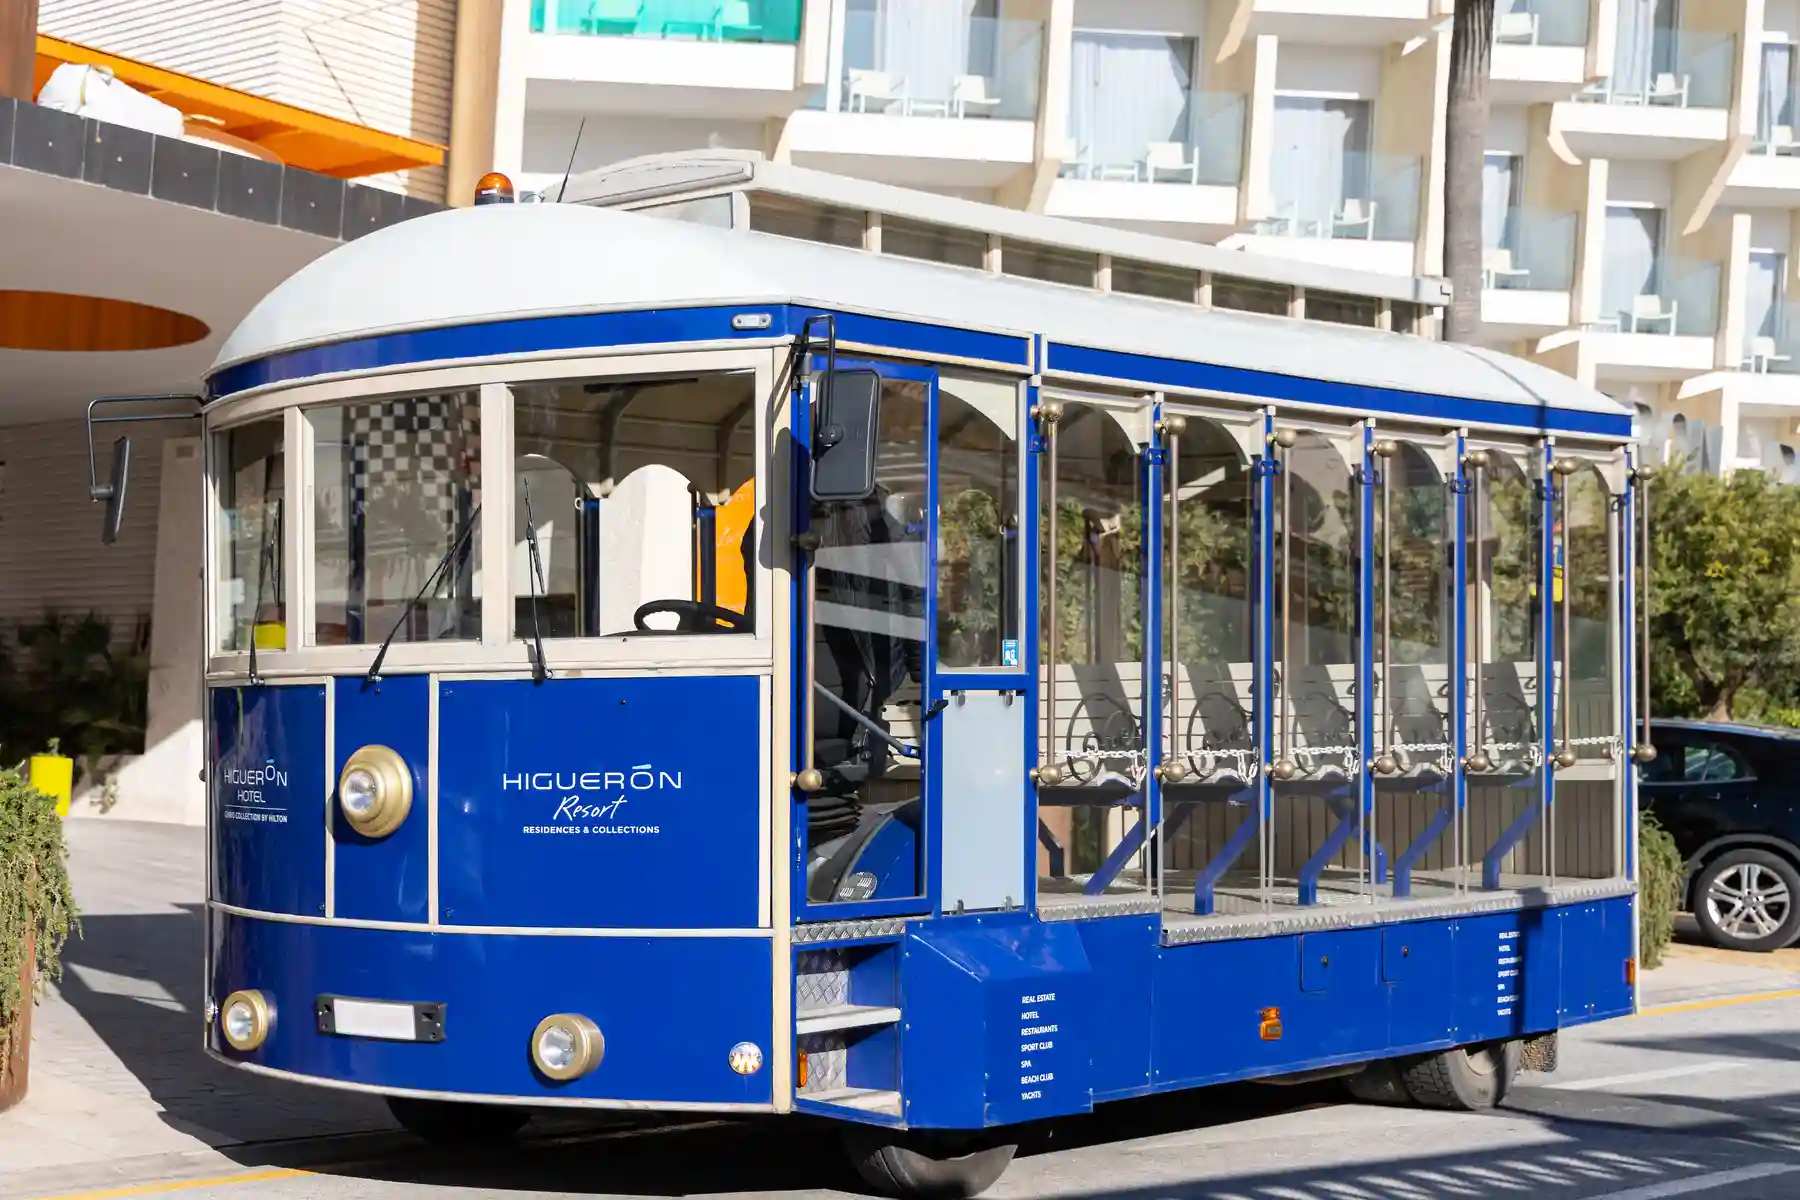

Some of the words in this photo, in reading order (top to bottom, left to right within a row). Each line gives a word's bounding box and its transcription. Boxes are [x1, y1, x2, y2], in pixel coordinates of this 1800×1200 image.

[237, 789, 266, 803] HOTEL
[553, 795, 628, 821] Resort
[261, 813, 268, 822] BY
[269, 814, 288, 823] HILTON
[523, 826, 580, 834] RESIDENCES
[583, 826, 590, 834] &
[592, 826, 660, 834] COLLECTIONS
[1022, 996, 1036, 1004] REAL
[1037, 993, 1056, 1002] ESTATE
[1021, 1011, 1040, 1020] HOTEL
[1021, 1025, 1058, 1036] RESTAURANTS
[1021, 1043, 1038, 1052] SPORT
[1039, 1041, 1053, 1050] CLUB
[1021, 1060, 1032, 1068] SPA
[1021, 1075, 1039, 1085] BEACH
[1040, 1073, 1054, 1082] CLUB
[1021, 1091, 1042, 1101] YACHTS
